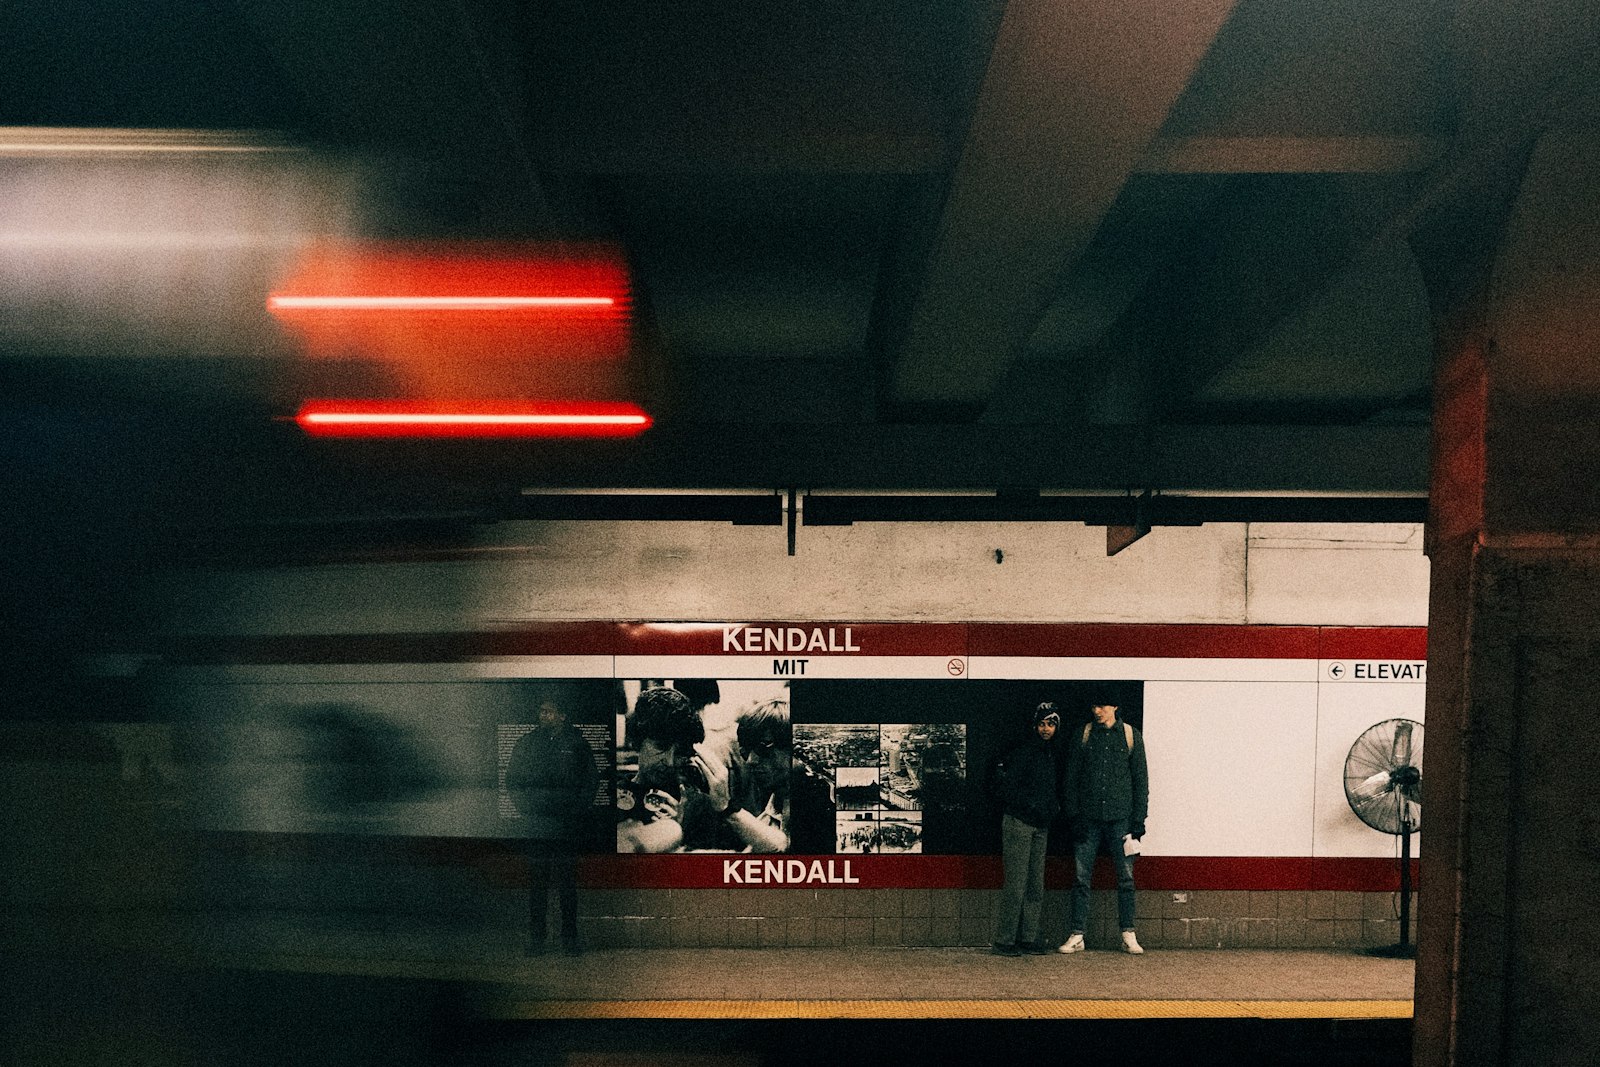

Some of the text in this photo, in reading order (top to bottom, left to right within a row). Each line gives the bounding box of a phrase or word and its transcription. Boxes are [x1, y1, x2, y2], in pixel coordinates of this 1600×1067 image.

[722, 627, 861, 652] KENDALL
[773, 659, 809, 675] MIT
[1354, 663, 1426, 679] ELEVAT
[723, 859, 860, 884] KENDALL
